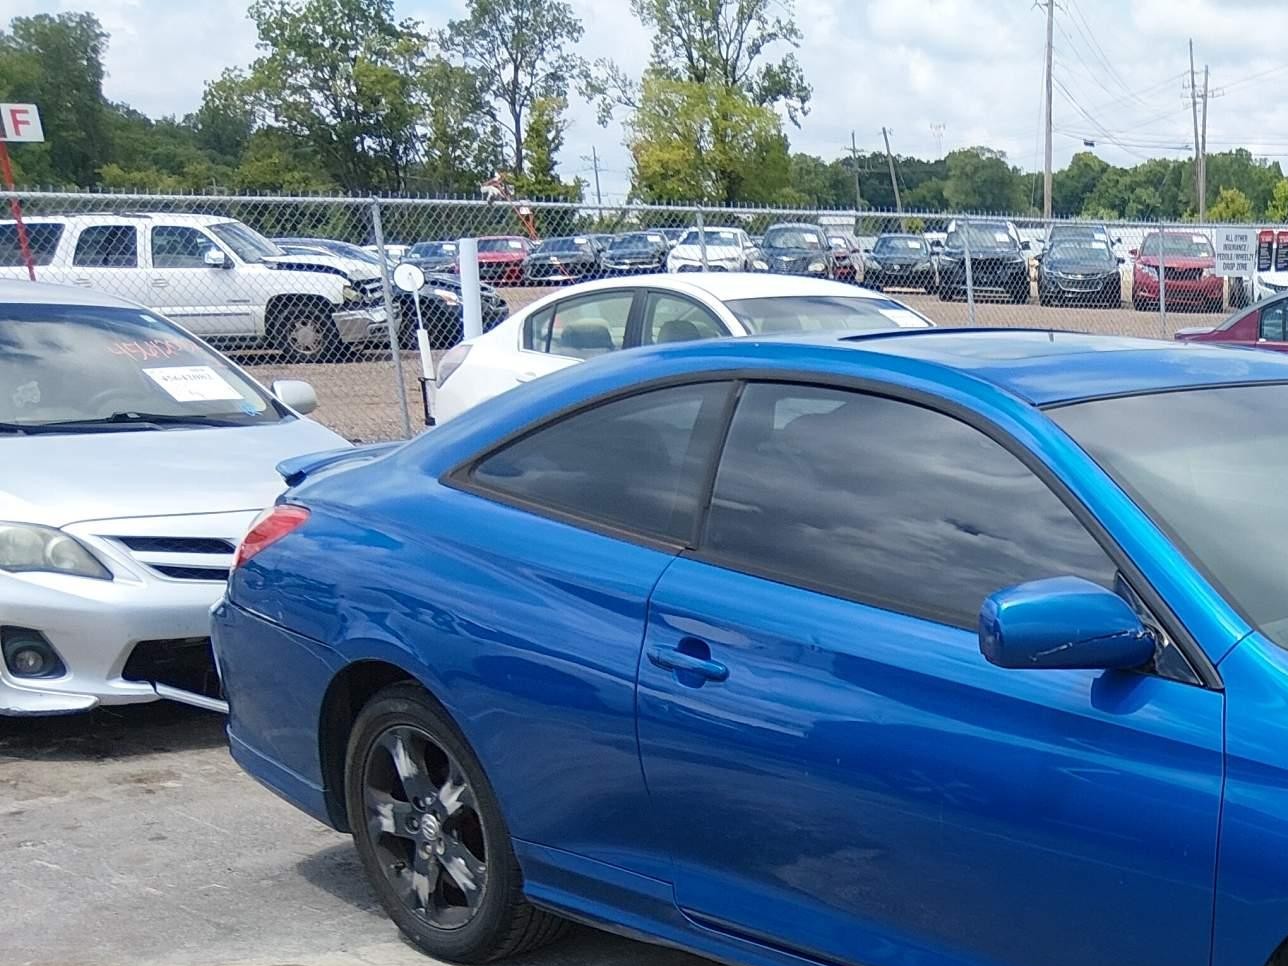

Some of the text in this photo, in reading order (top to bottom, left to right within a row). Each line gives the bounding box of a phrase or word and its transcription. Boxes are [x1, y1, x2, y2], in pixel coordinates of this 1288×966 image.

[10, 109, 31, 136] F
[1225, 234, 1248, 242] ALL OTHER
[1223, 262, 1248, 271] DROP ZONE
